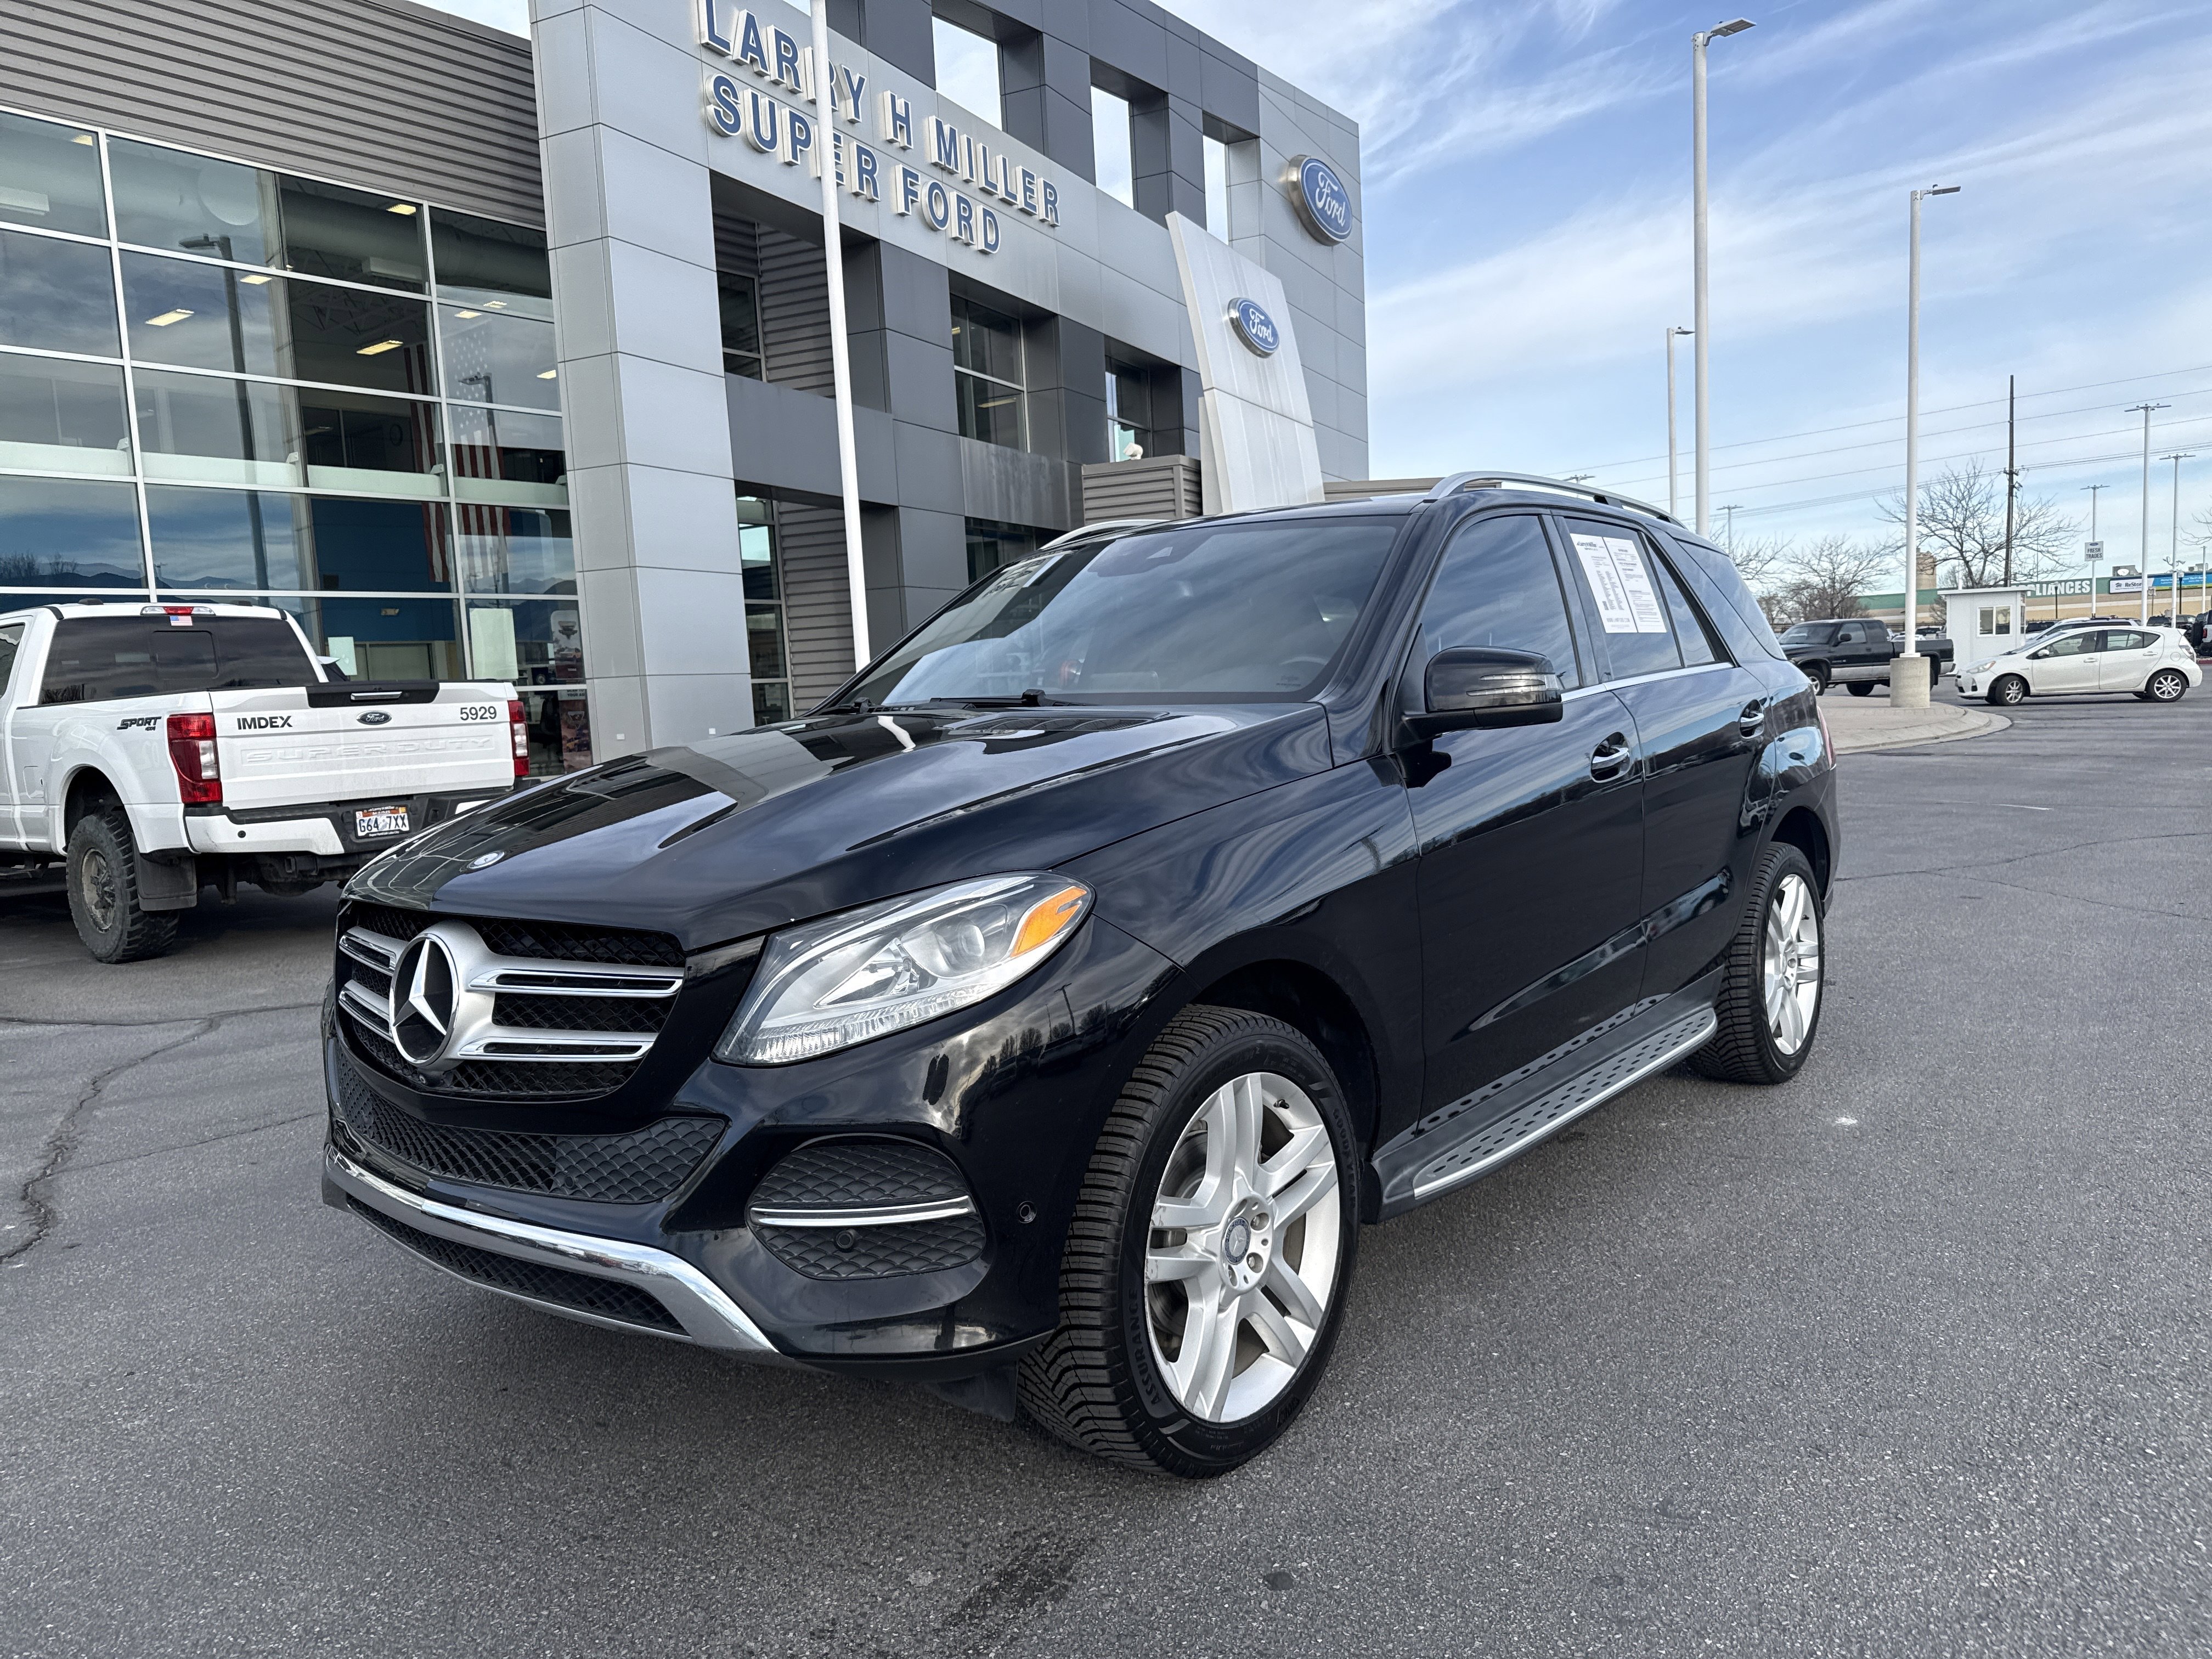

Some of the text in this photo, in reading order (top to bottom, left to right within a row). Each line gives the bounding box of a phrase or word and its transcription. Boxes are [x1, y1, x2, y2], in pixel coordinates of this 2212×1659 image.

[884, 90, 913, 150] H
[929, 115, 1060, 227] MILLER
[895, 163, 1001, 254] FORD
[1315, 171, 1346, 227] Ford
[1249, 308, 1274, 343] Ford
[2011, 580, 2091, 597] PLIANCES
[117, 716, 162, 730] SPORT
[236, 715, 293, 730] IMDEX
[365, 713, 385, 724] Ford
[460, 706, 497, 721] 5929
[246, 737, 492, 763] SUPER DUTY
[386, 814, 407, 830] 7XX
[1128, 1288, 1160, 1406] ASSURANCE
